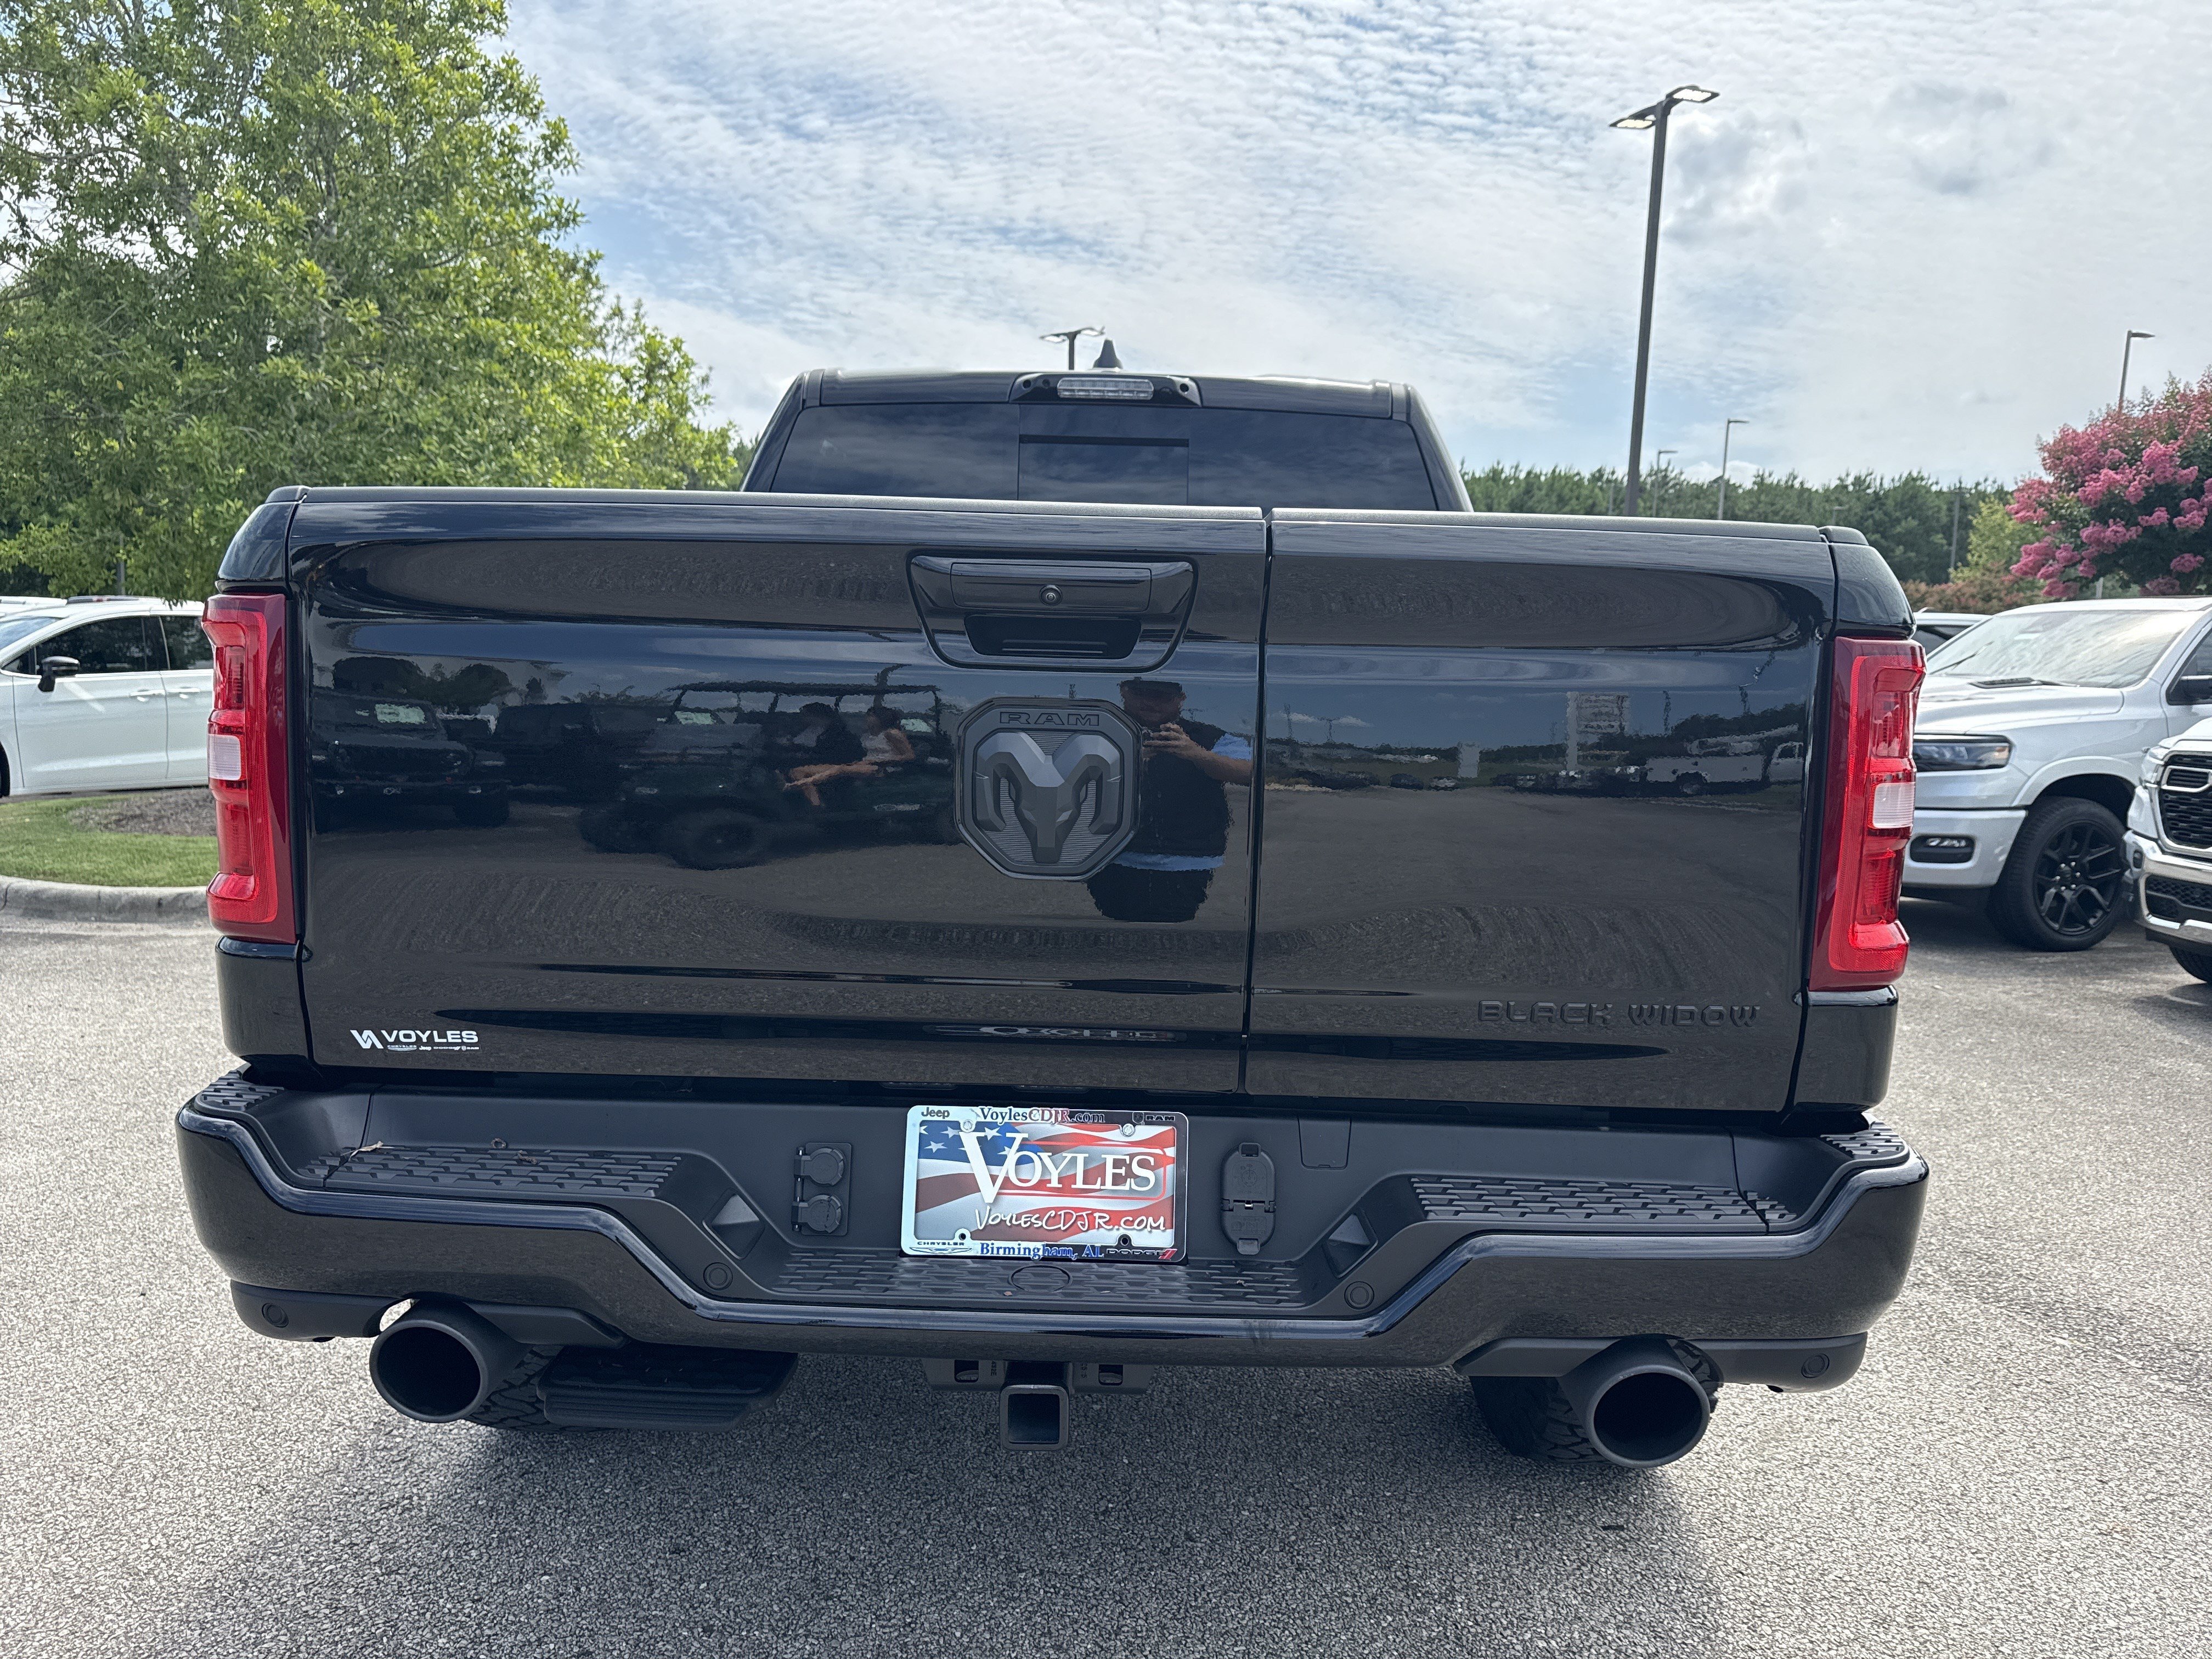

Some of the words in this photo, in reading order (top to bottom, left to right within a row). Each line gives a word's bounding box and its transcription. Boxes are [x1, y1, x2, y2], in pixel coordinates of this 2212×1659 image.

[1000, 712, 1099, 726] RAM
[1479, 1000, 1612, 1024] BLACK
[1628, 1005, 1760, 1028] WIDOW
[381, 1030, 478, 1042] VOYLES
[921, 1107, 950, 1119] Jeep
[979, 1107, 1105, 1124] VoylesCDJR.com
[959, 1131, 1156, 1203] VOYLES
[980, 1242, 1077, 1260] Birmingham,
[1081, 1244, 1105, 1258] AL
[1106, 1248, 1165, 1256] DODGE
